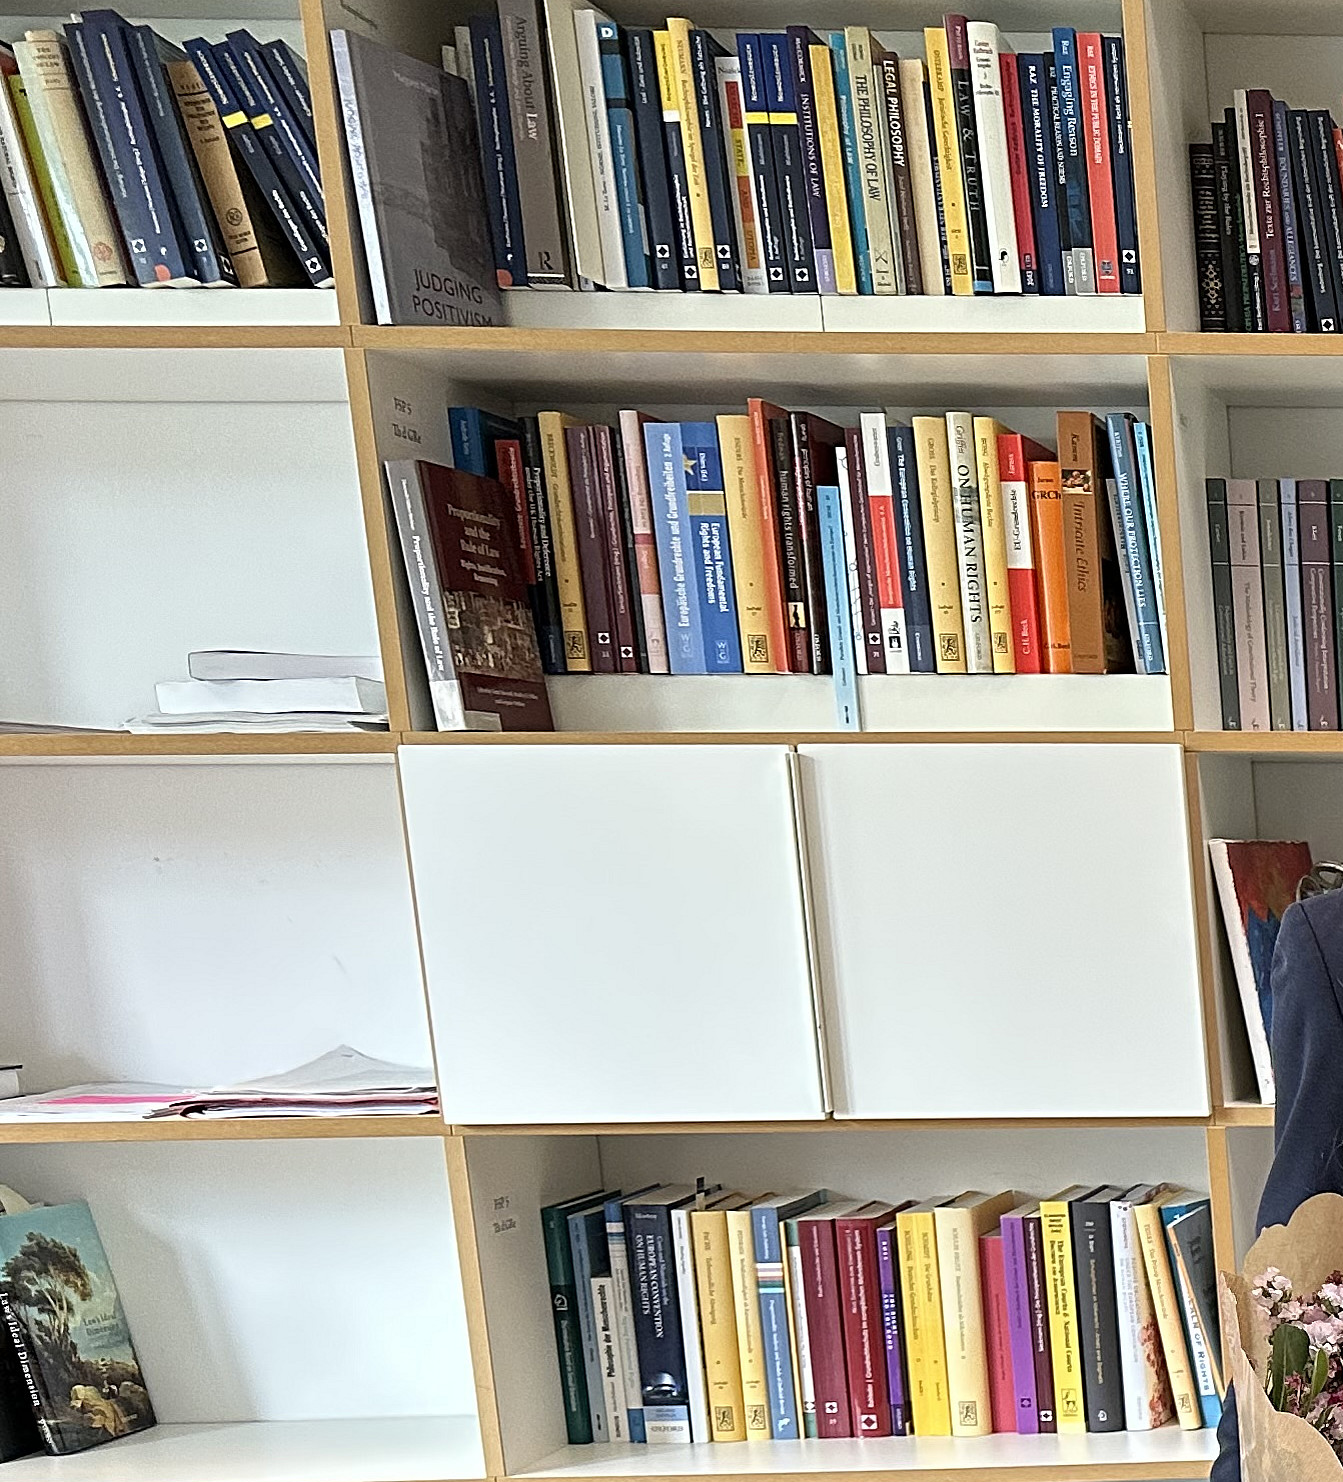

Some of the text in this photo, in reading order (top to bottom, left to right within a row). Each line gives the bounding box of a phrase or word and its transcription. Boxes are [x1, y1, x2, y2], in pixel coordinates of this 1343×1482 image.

[515, 16, 538, 140] Arguing About Law
[1028, 65, 1037, 84] RAZ
[1030, 89, 1040, 106] THE
[1061, 65, 1076, 115] Engaging
[883, 60, 904, 167] LEGAL PHILOSOPHY
[1032, 108, 1044, 153] MORALITY
[1067, 117, 1079, 156] Reason
[800, 94, 821, 198] INSTITUTIONS OF LAW
[856, 75, 880, 201] THE PHILOSOPHY OF LAW
[957, 80, 980, 211] LAW & TRUTH
[1037, 167, 1048, 208] FREEDOM
[1263, 200, 1272, 214] zur
[1266, 216, 1274, 238] Texte
[413, 268, 484, 304] JUDGING
[412, 295, 493, 327] POSITIVISM
[1118, 473, 1131, 506] WHERE
[779, 471, 799, 589] human rights transformed
[1072, 500, 1085, 554] Intricate
[1122, 508, 1135, 528] OUR
[662, 462, 691, 627] Europäische Grundrechte und Grundfreiheiten
[699, 523, 718, 604] Rights and Freedoms
[708, 523, 729, 612] European Fundamental
[956, 465, 982, 623] ON HUMAN RIGHTS
[1075, 558, 1089, 592] Ethics
[1135, 589, 1146, 607] LIES
[635, 1235, 651, 1315] ON HUMAN RIGHTS
[645, 1234, 664, 1338] EUROPEAN CONVENTION
[1196, 1351, 1210, 1391] RIGHTS
